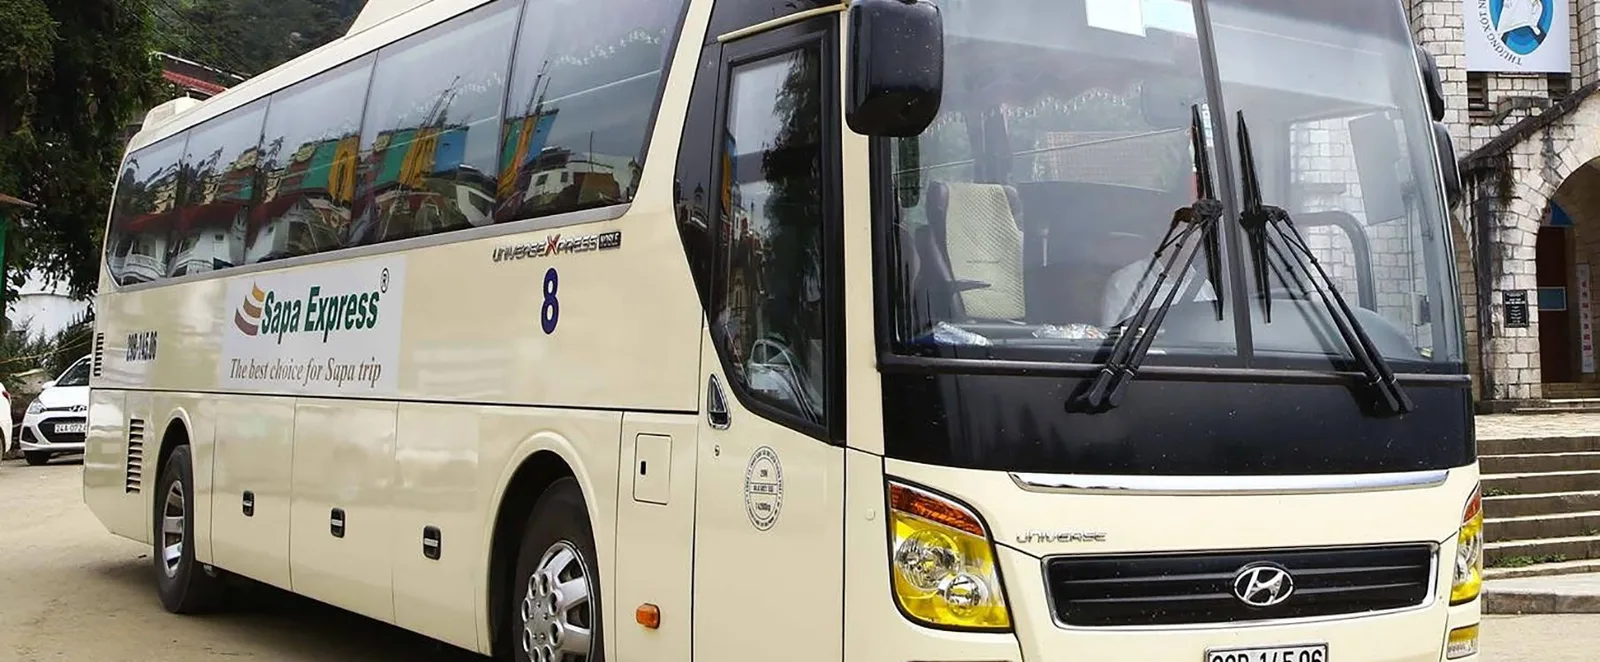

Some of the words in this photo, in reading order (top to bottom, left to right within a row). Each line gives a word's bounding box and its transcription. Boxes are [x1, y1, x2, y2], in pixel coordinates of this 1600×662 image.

[261, 290, 302, 345] Sapa
[304, 285, 380, 343] Express
[541, 268, 559, 334] 8
[230, 358, 248, 379] The
[249, 358, 268, 379] best
[270, 358, 303, 380] choice
[302, 357, 323, 387] for
[325, 357, 355, 388] Sapa
[358, 356, 381, 388] trip
[1016, 531, 1107, 543] UNIVERSE
